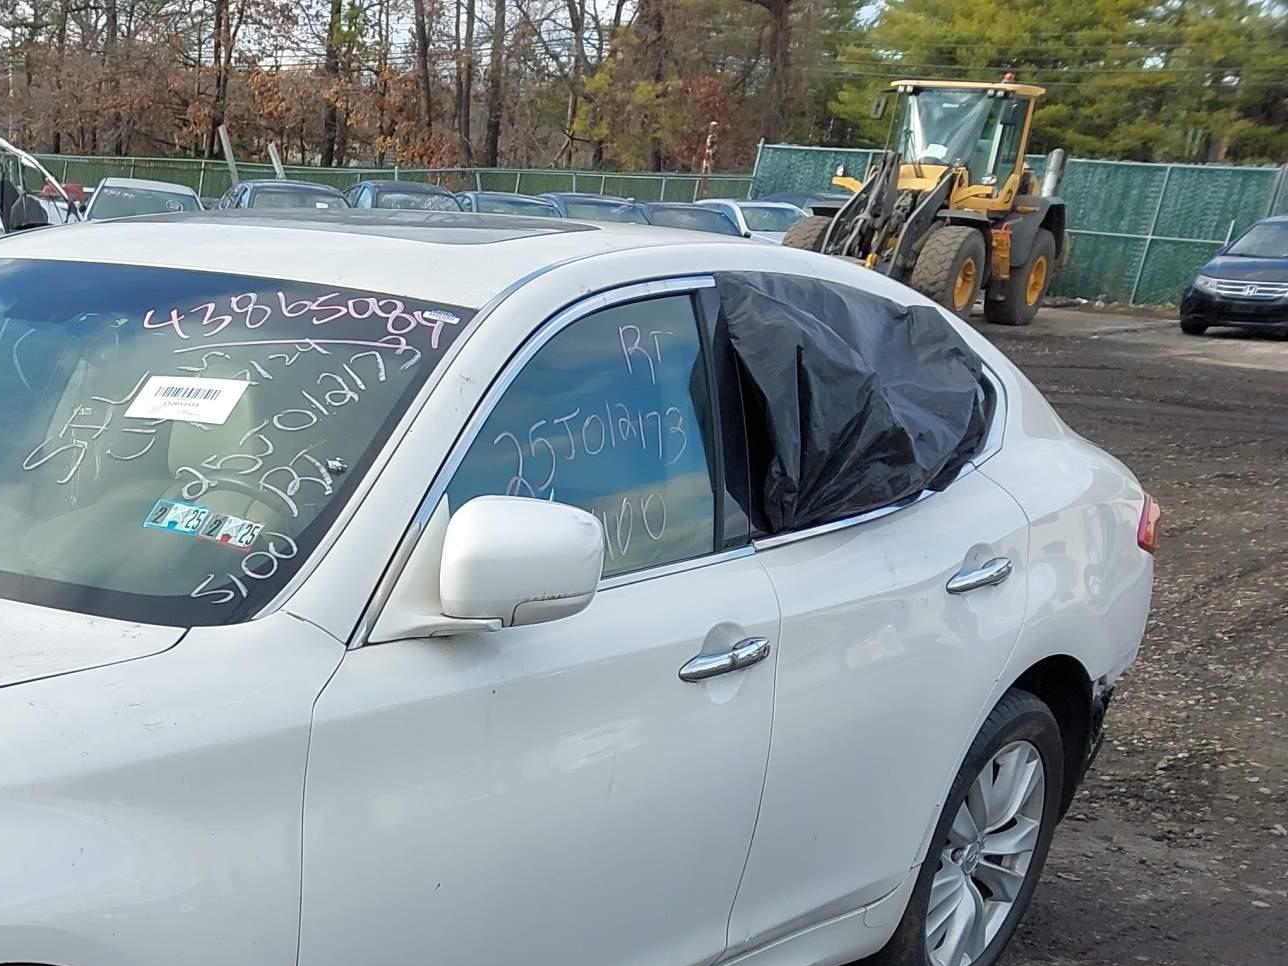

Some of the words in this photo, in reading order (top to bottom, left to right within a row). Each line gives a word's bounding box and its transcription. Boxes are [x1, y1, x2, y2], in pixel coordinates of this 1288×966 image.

[618, 324, 673, 384] RT
[493, 400, 688, 497] 25J012173
[152, 506, 168, 524] 2
[184, 509, 206, 531] 25
[205, 519, 222, 537] 2
[238, 524, 261, 545] 25
